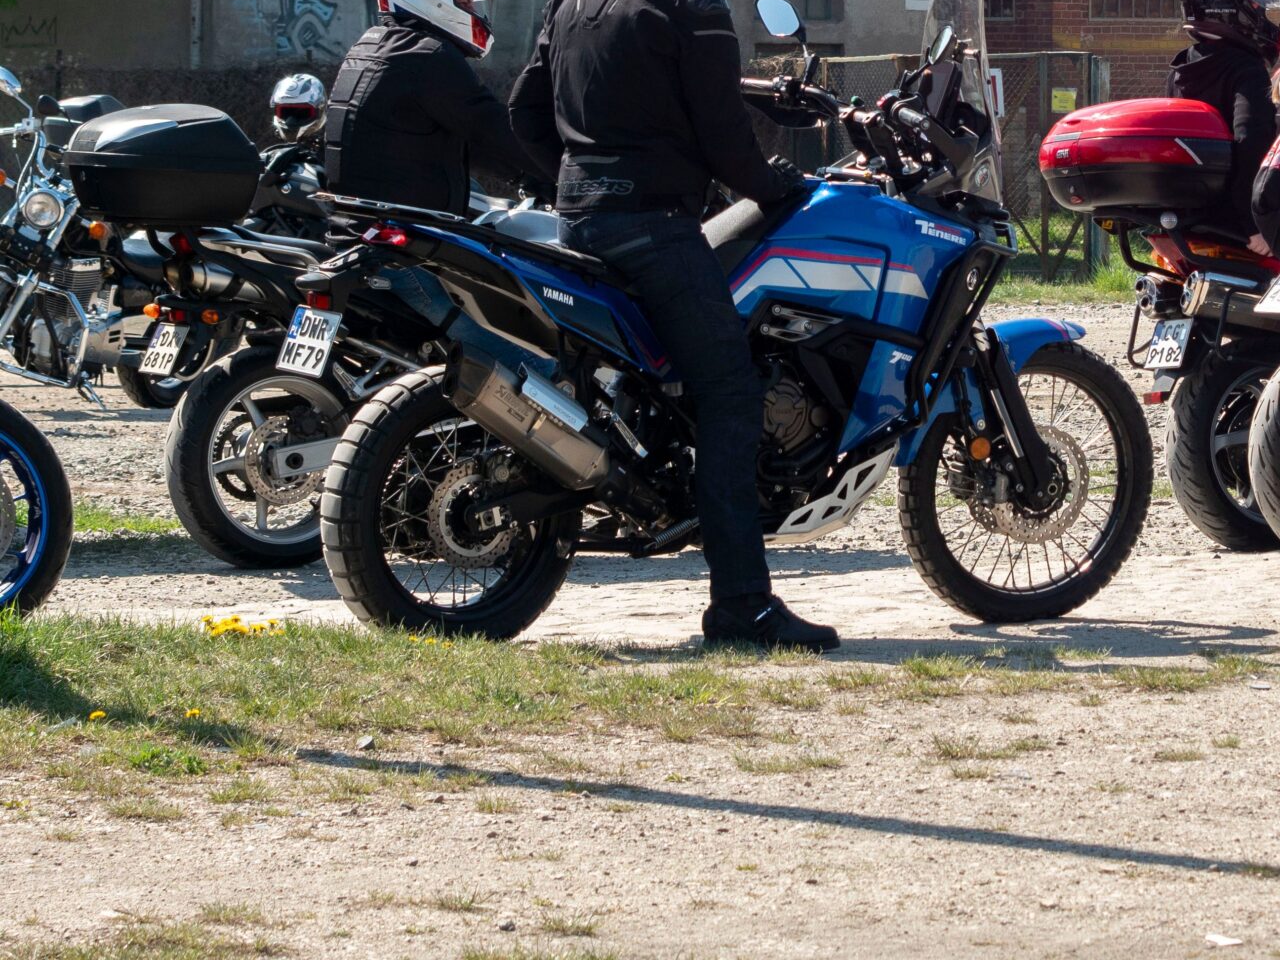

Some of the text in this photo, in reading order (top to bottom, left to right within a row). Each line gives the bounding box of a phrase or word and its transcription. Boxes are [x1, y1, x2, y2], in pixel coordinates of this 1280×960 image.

[543, 286, 574, 306] YAMAHA
[299, 315, 330, 342] DWR
[159, 330, 179, 348] DX
[144, 351, 173, 370] 681P
[281, 343, 325, 369] MF79
[1148, 346, 1182, 364] 9182
